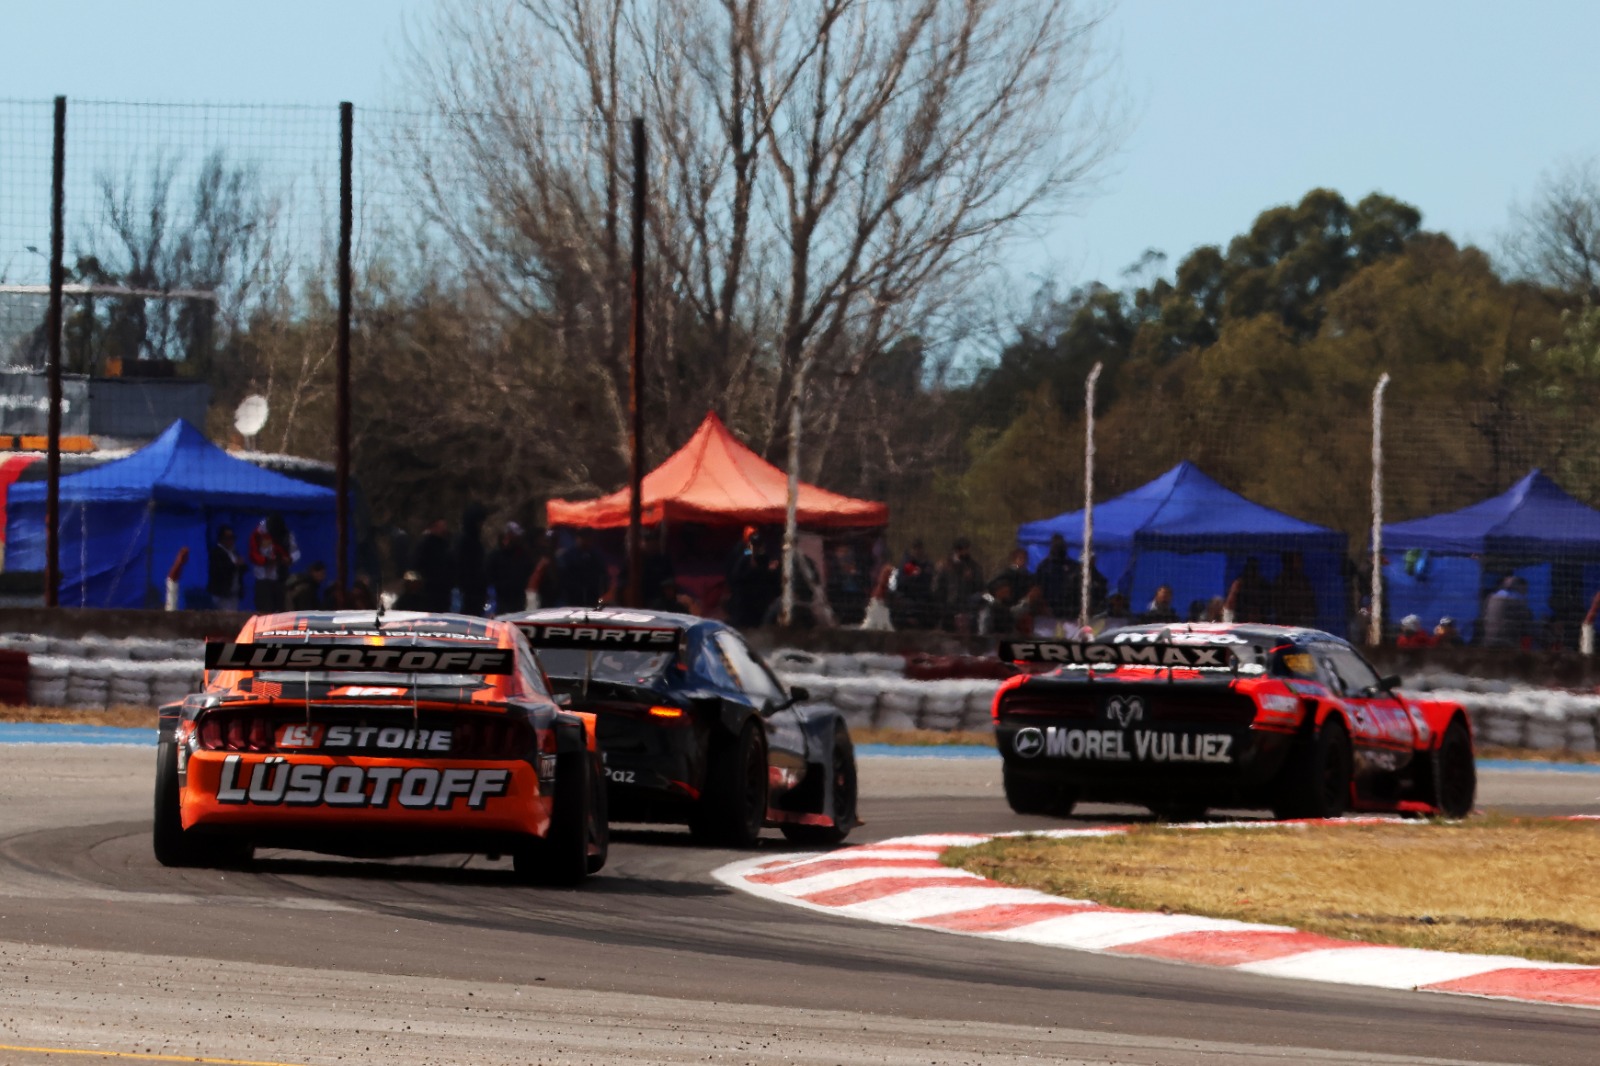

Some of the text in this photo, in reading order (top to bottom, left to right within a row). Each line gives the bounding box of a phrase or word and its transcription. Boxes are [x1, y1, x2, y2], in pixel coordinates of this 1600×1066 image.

[544, 627, 675, 643] PARTS
[216, 642, 506, 668] LÜSQTOFF
[324, 725, 453, 751] STORE
[1047, 726, 1234, 763] MOREL VULLIEZ
[216, 755, 509, 808] LÜSQTOFF
